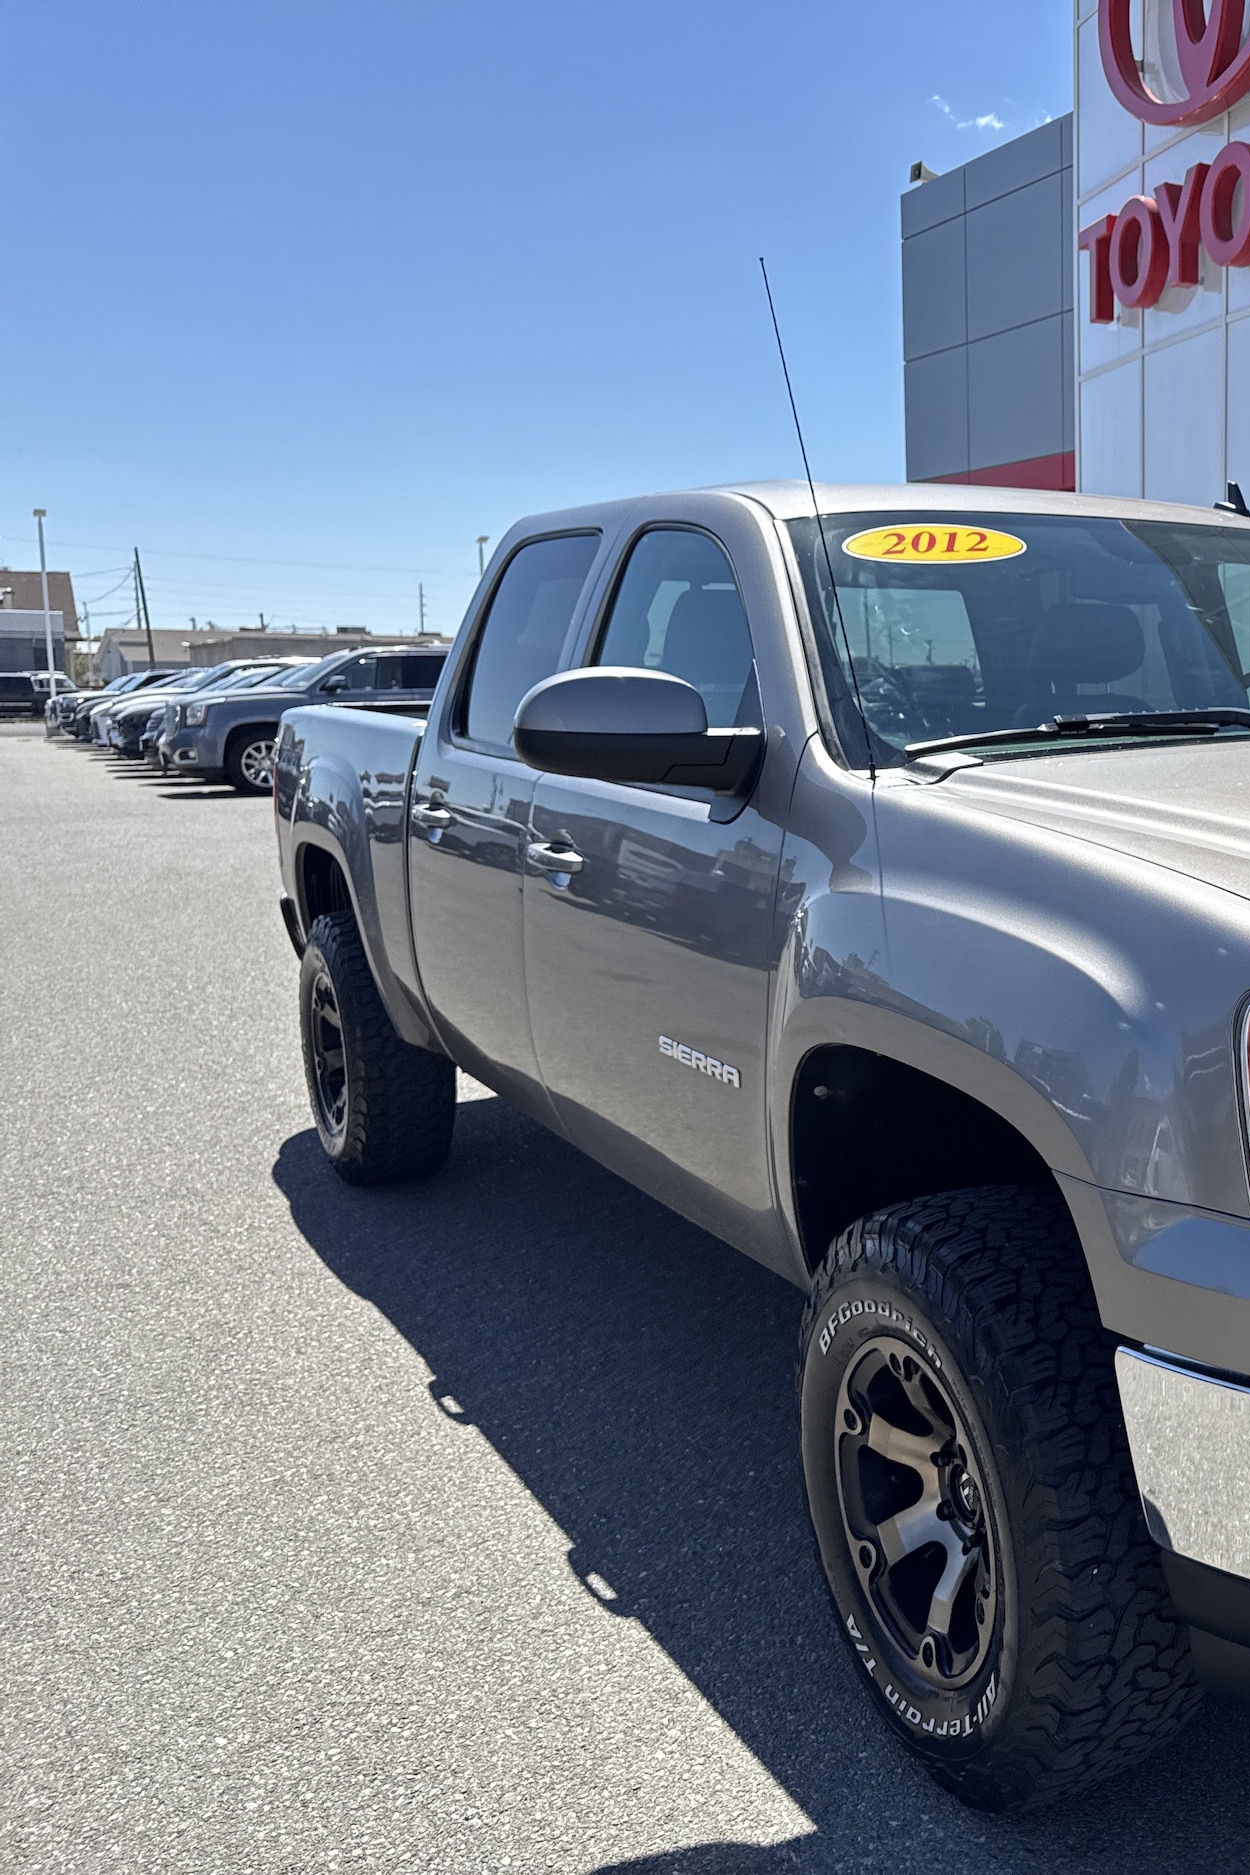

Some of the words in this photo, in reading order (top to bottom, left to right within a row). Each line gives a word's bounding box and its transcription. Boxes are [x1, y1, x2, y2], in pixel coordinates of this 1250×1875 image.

[882, 531, 989, 555] 2012
[659, 1035, 741, 1088] SIERRA
[819, 1300, 943, 1369] BFGoodrich
[846, 1614, 877, 1677] T/A
[884, 1672, 998, 1738] All-Terrain
